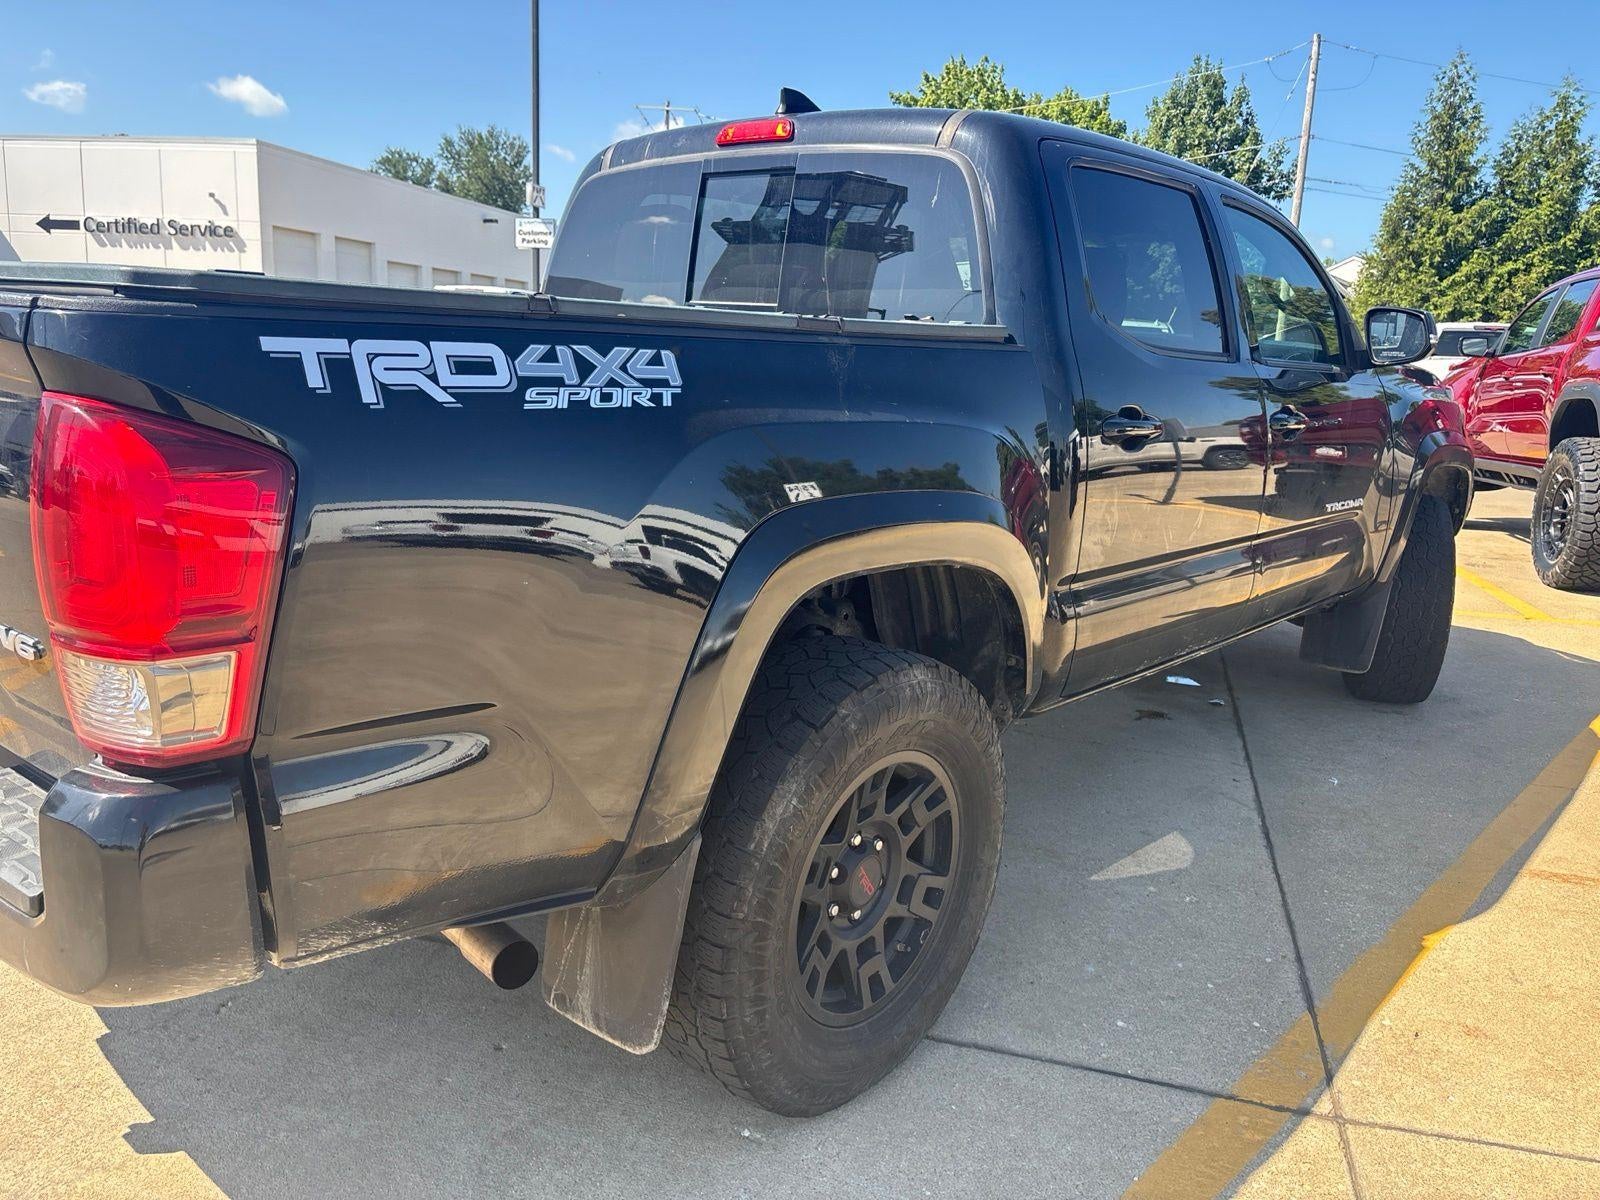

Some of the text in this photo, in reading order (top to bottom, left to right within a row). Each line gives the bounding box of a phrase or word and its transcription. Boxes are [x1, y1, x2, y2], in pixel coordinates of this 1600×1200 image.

[83, 216, 234, 238] Certified Service
[518, 229, 552, 237] Customer
[521, 237, 549, 246] Parking
[259, 336, 517, 408] TRD
[523, 387, 682, 409] SPORT
[0, 624, 39, 660] V6
